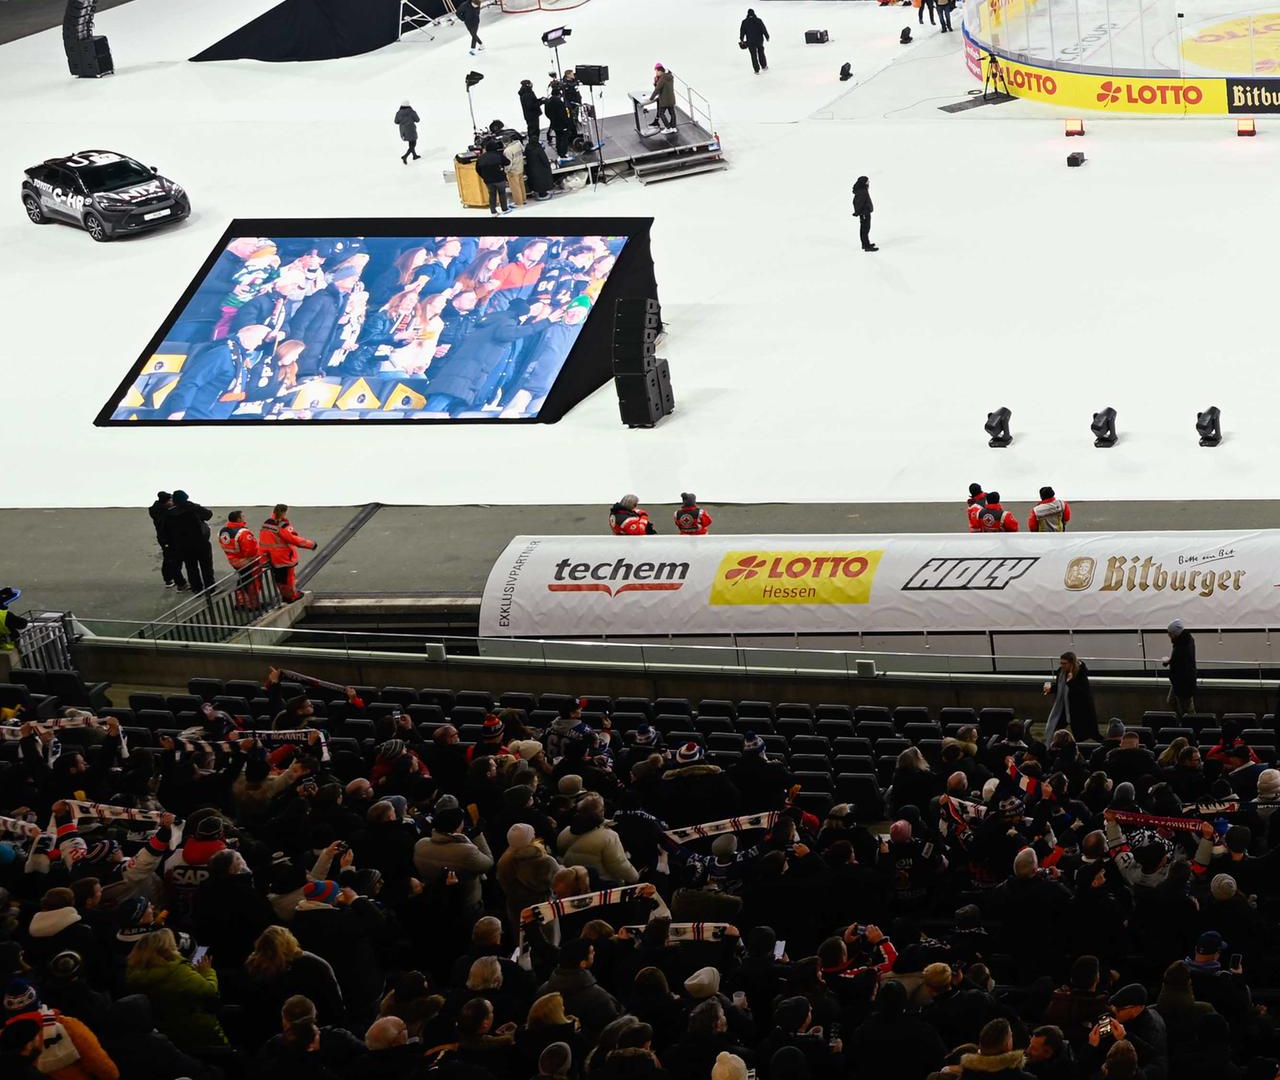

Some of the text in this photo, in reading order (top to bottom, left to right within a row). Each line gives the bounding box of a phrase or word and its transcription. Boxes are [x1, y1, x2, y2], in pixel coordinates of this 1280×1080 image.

[1005, 65, 1057, 95] LOTTO
[1126, 84, 1203, 105] LOTTO
[33, 178, 53, 195] TOYOTA
[118, 181, 160, 199] NIX
[52, 187, 84, 214] C-HR
[554, 557, 690, 582] techem
[769, 555, 869, 580] LOTTO
[901, 557, 1040, 591] HOLY
[1098, 555, 1247, 598] Bitburger
[498, 538, 541, 628] EXKLUSIVPARTNER
[761, 584, 817, 602] Hessen
[173, 868, 210, 886] SAP
